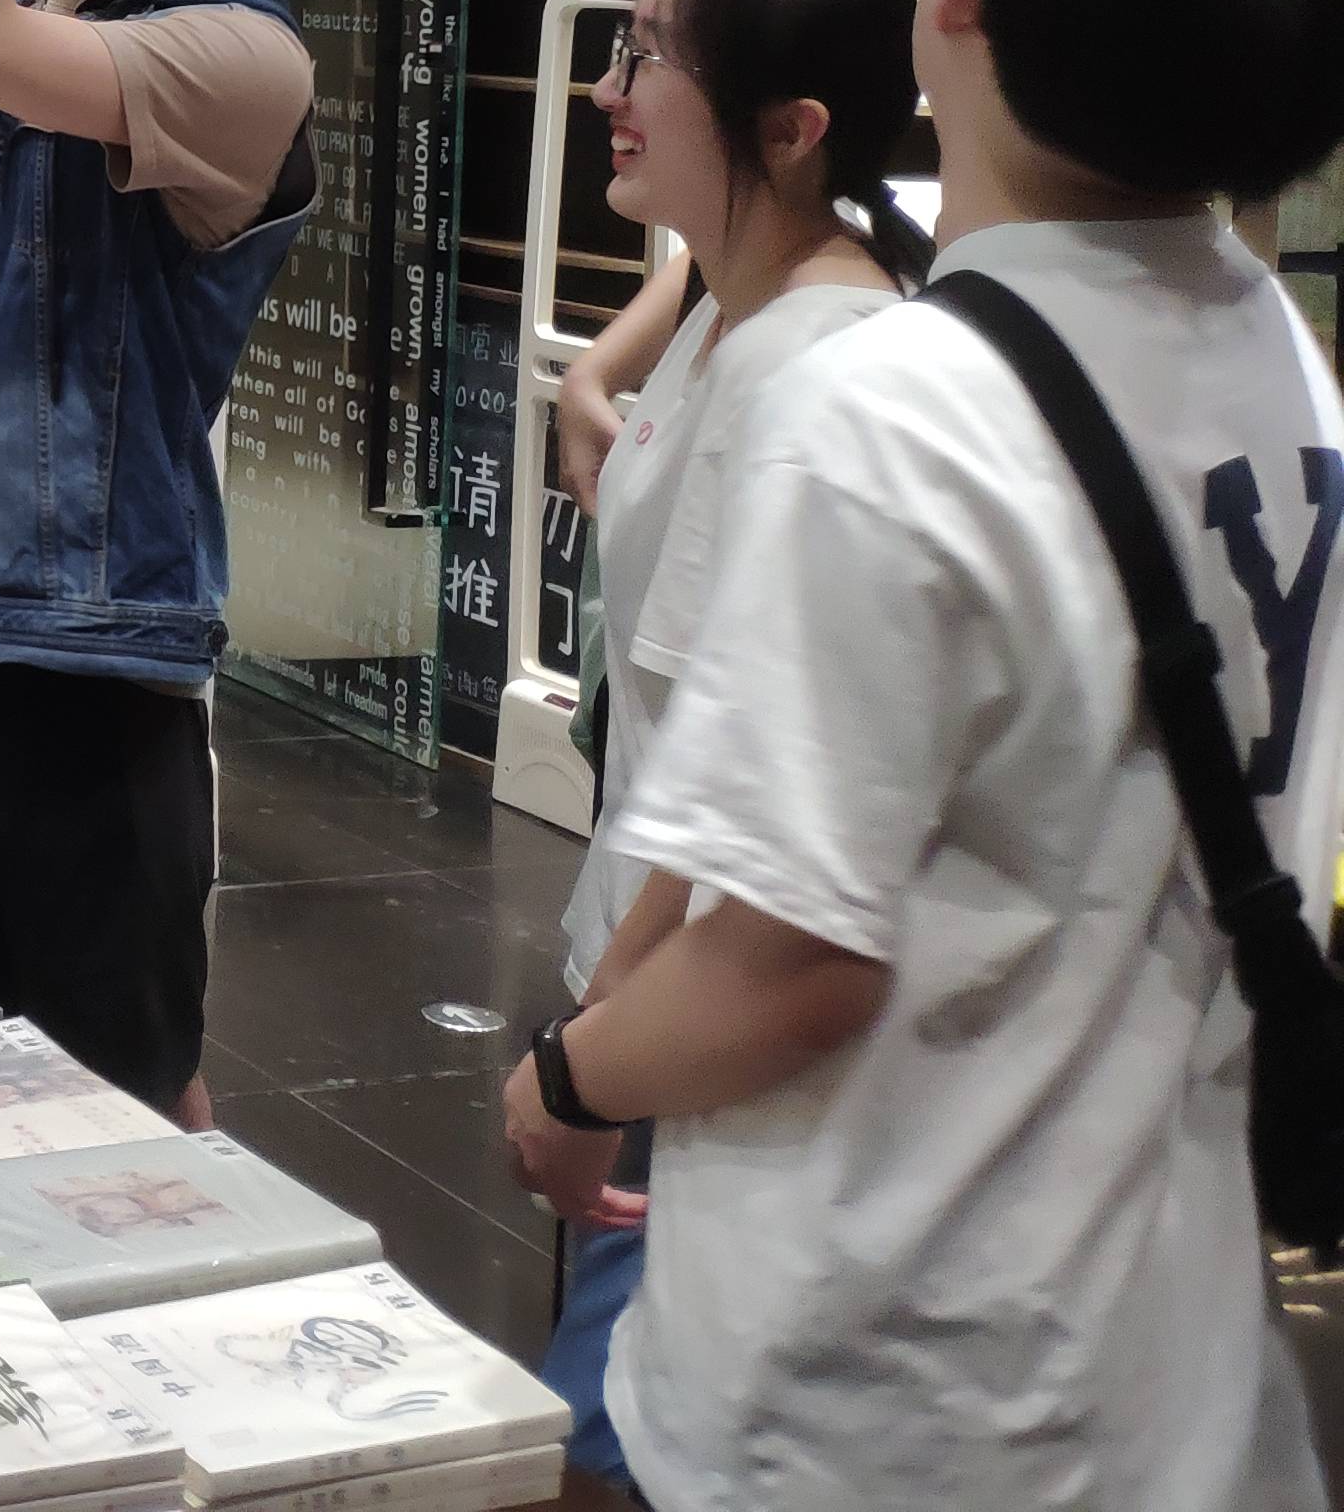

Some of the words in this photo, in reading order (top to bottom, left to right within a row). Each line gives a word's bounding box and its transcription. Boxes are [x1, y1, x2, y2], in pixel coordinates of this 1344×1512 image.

[410, 119, 431, 232] women
[435, 217, 450, 251] had
[284, 299, 323, 334] will
[329, 307, 359, 342] be
[403, 264, 428, 369] grown,
[428, 271, 445, 348] amongst
[249, 343, 284, 371] this
[291, 351, 324, 382] will
[334, 363, 358, 389] be
[428, 368, 443, 396] my
[231, 373, 276, 400] when
[284, 379, 309, 407] all
[315, 392, 337, 416] of
[274, 410, 305, 438] will
[318, 422, 342, 448] be
[230, 430, 267, 462] sing
[292, 447, 332, 477] with
[426, 416, 443, 491] scholars
[452, 444, 501, 540] 请
[444, 552, 500, 630] 推
[343, 681, 389, 723] freedom
